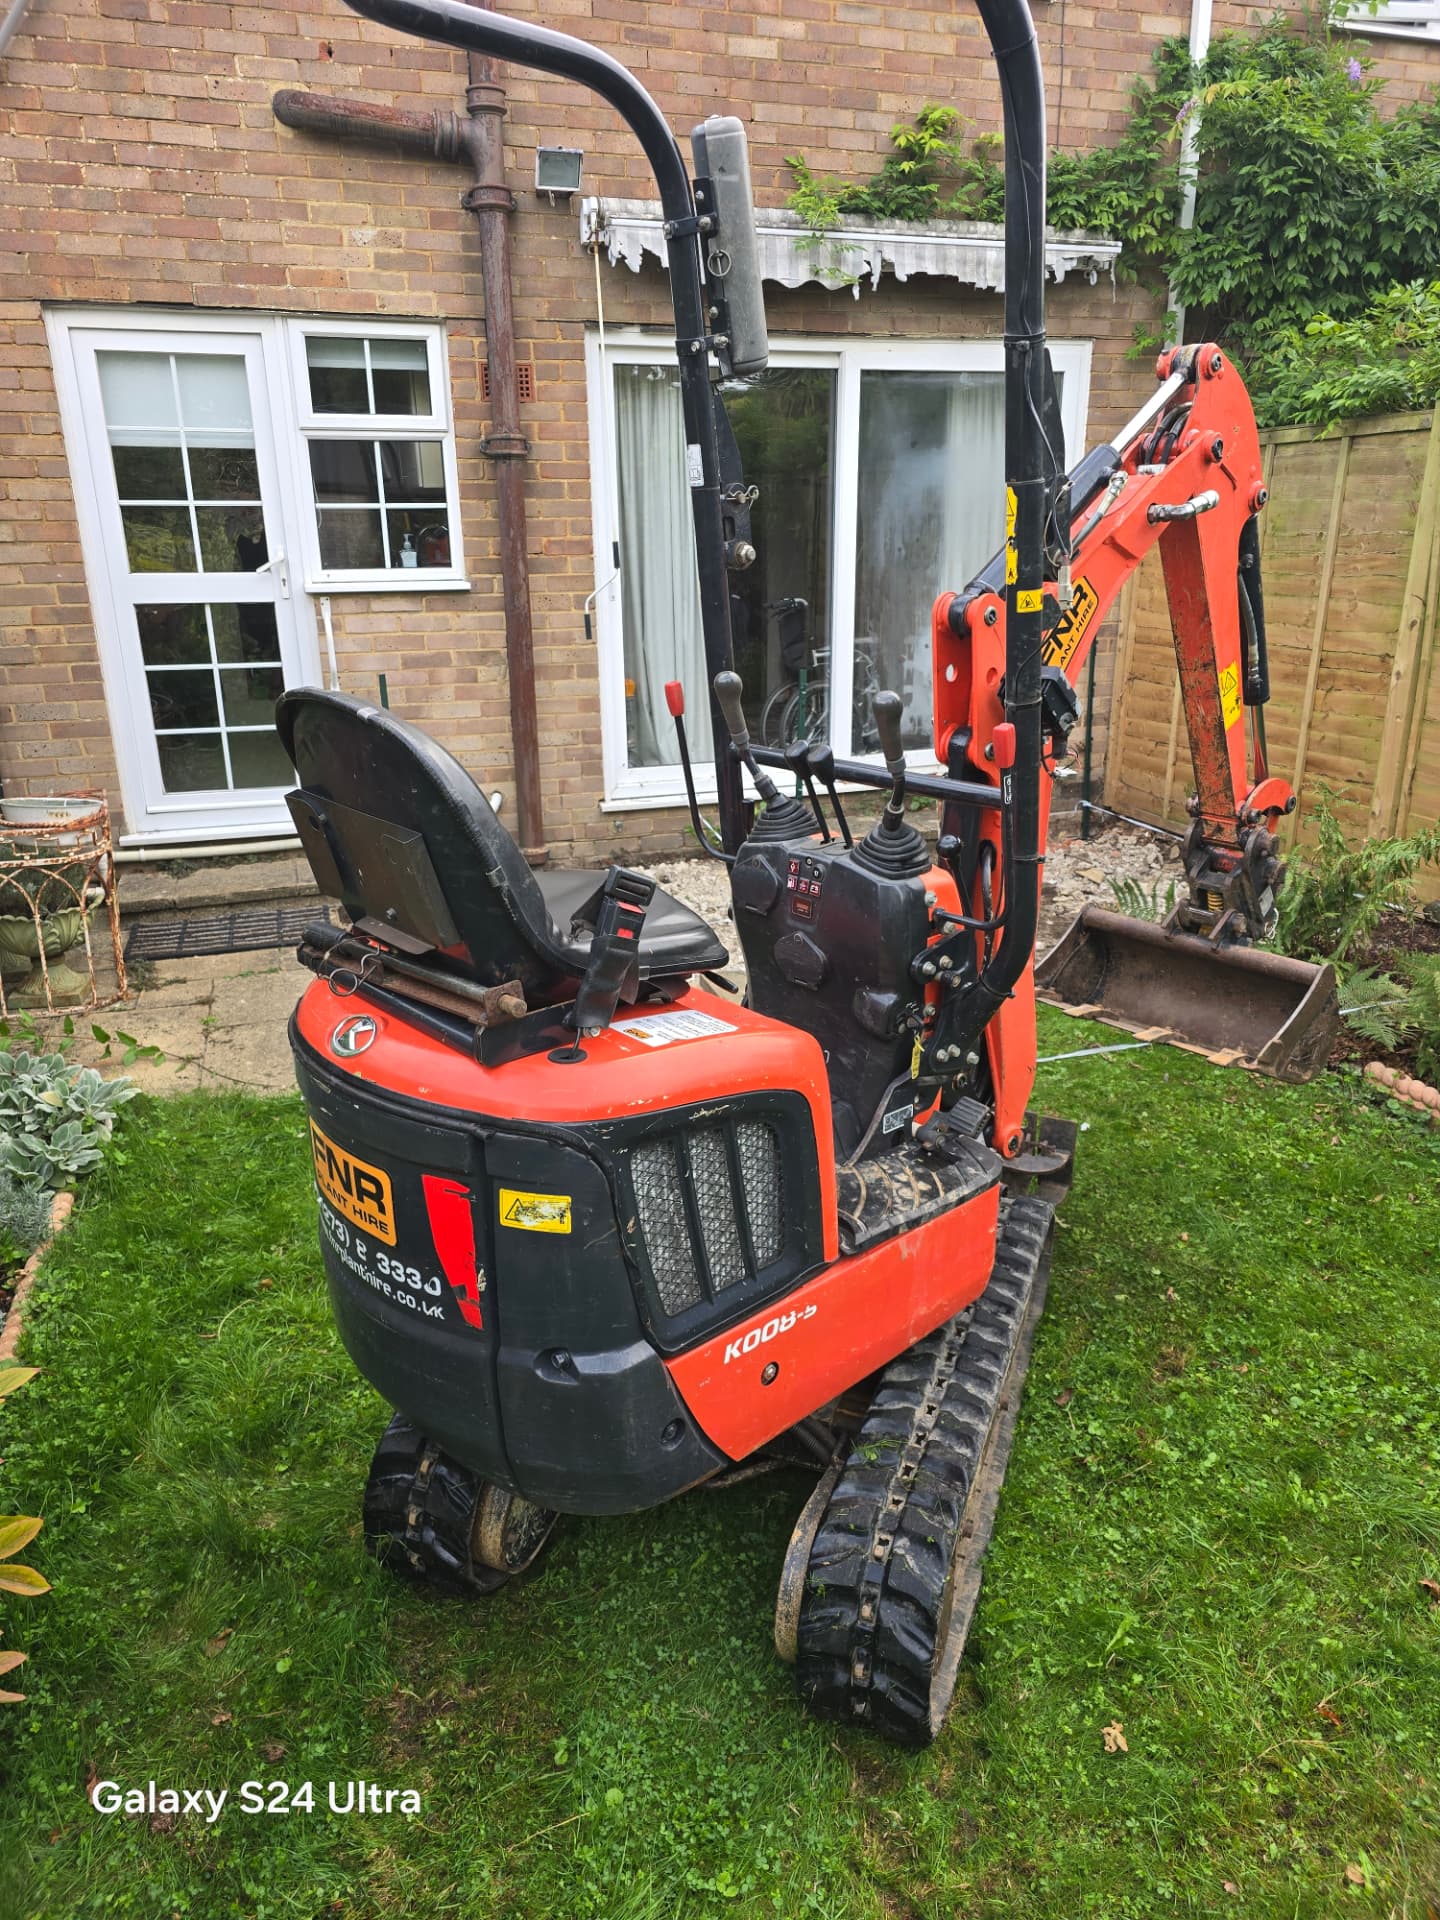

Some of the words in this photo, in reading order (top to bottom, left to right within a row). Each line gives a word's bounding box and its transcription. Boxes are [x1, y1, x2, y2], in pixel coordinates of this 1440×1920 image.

[1060, 635, 1075, 666] ANT
[312, 1125, 386, 1216] FNR
[352, 1204, 390, 1236] HIRE
